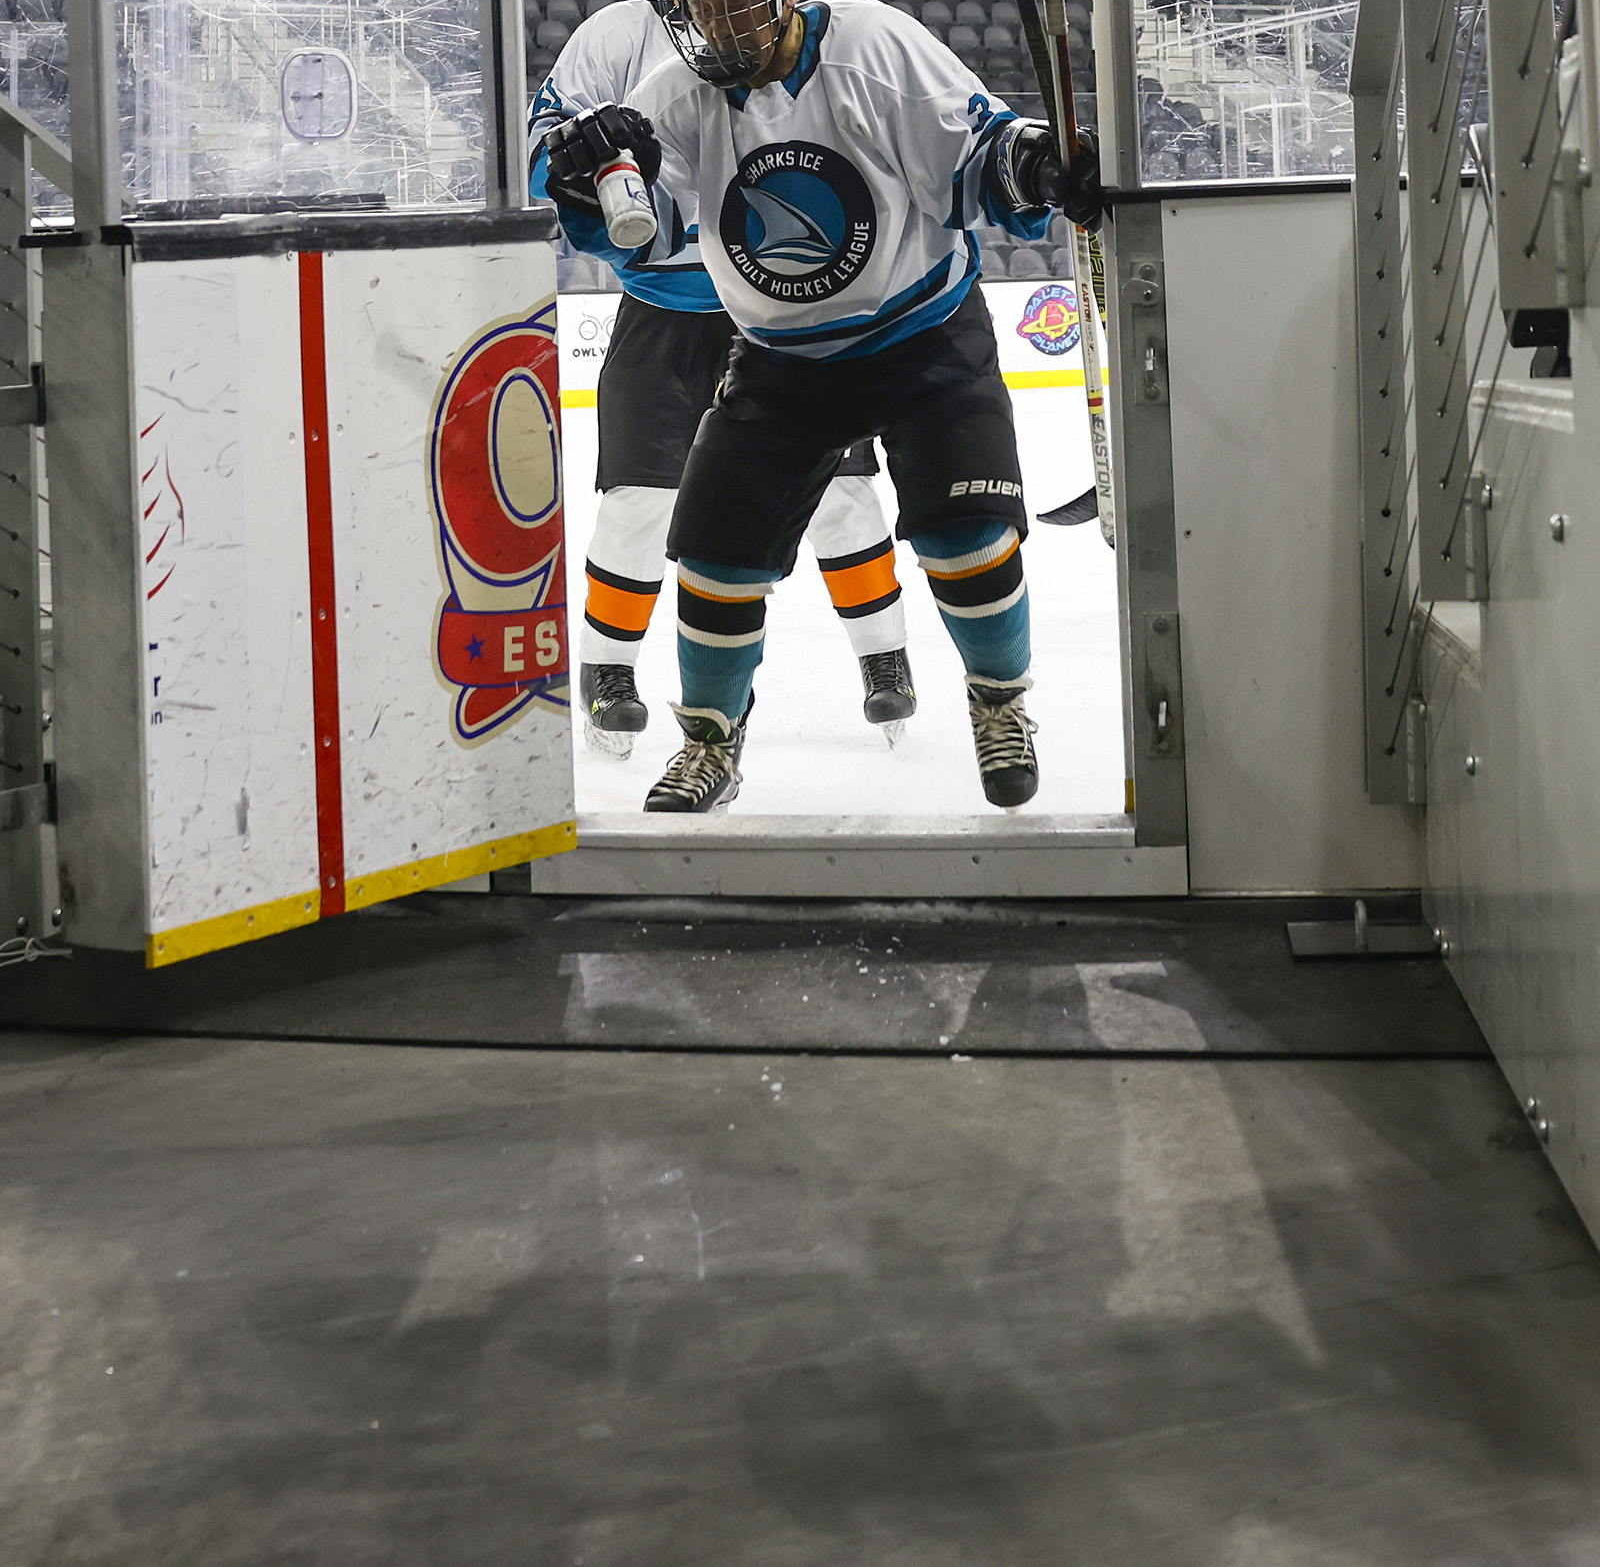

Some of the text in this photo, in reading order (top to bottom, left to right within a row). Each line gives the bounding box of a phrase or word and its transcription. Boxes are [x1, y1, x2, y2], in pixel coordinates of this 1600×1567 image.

[745, 150, 824, 184] SHARKS ICE
[729, 221, 870, 296] ADULT HOCKEY LEAGUE
[1025, 286, 1077, 319] PALETA
[1081, 283, 1092, 322] EASTON
[572, 347, 597, 358] OWL
[1092, 414, 1111, 499] EASTON
